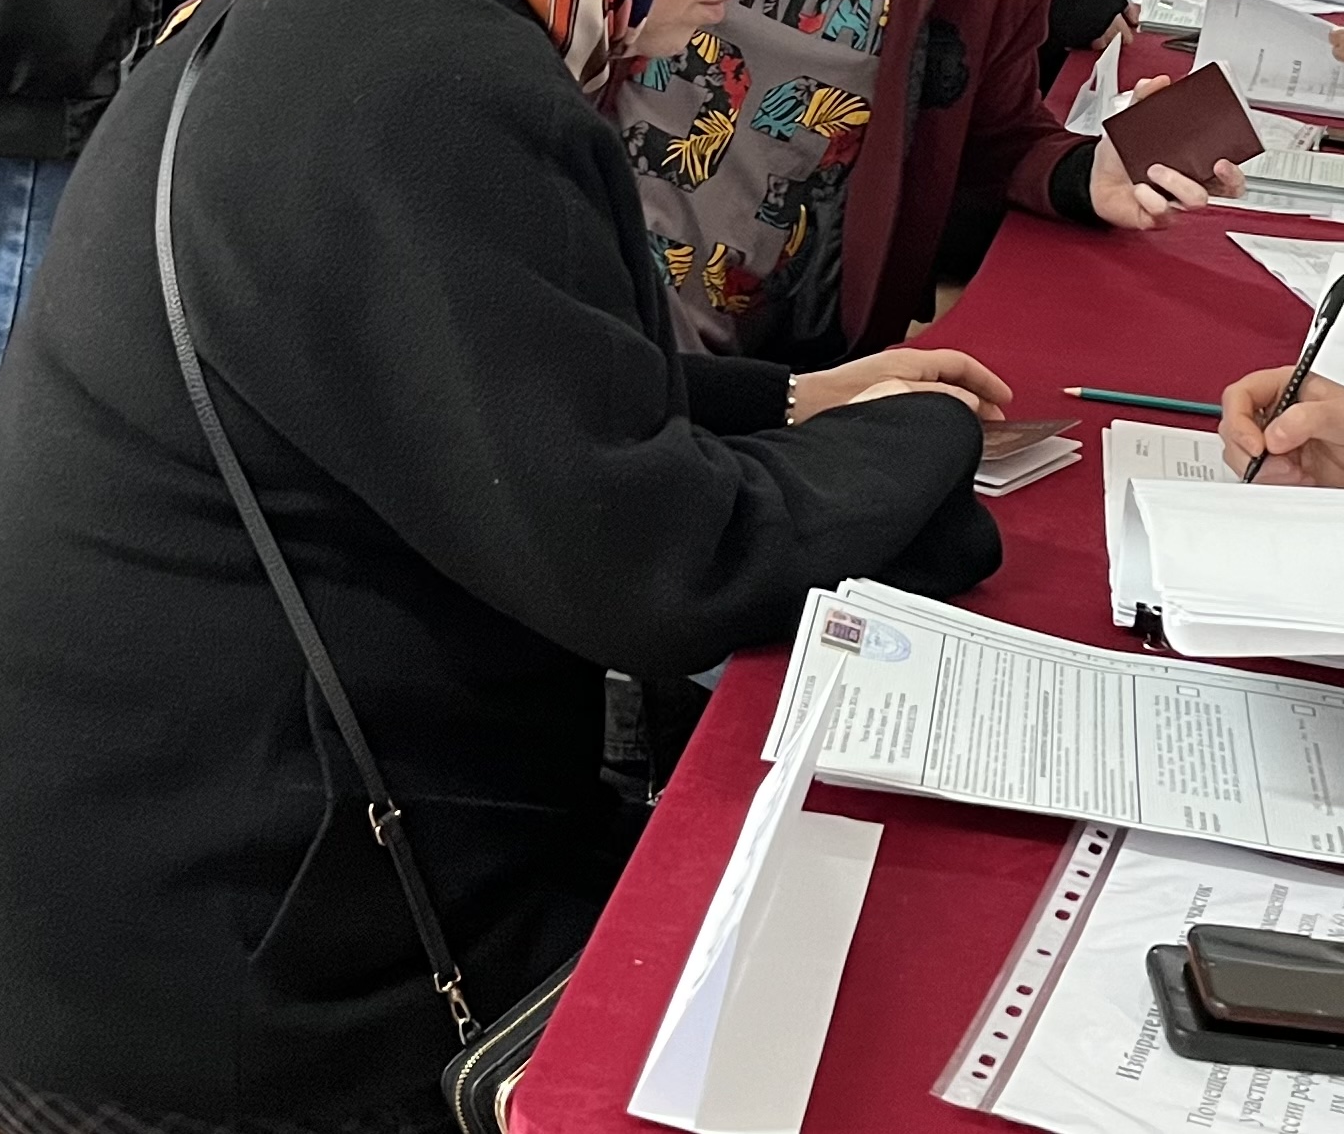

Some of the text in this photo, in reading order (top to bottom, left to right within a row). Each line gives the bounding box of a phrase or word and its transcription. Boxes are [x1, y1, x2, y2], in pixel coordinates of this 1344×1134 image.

[1186, 1064, 1231, 1128] Помещен
[1239, 1066, 1273, 1127] участков
[1277, 1101, 1306, 1134] ссии
